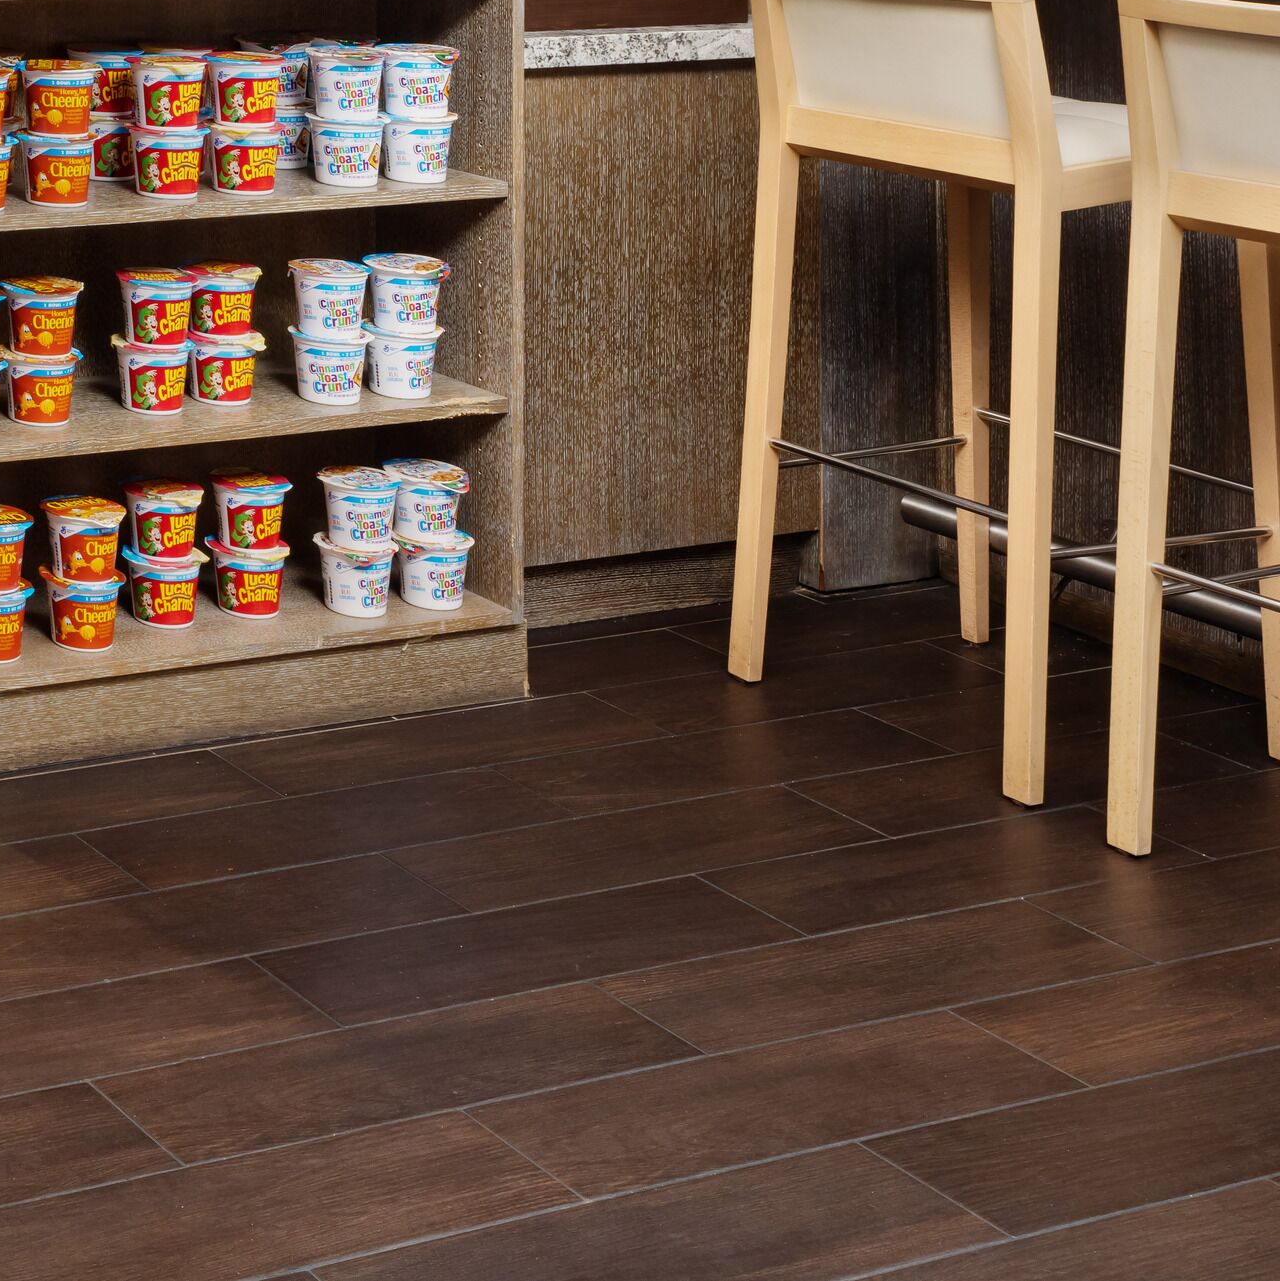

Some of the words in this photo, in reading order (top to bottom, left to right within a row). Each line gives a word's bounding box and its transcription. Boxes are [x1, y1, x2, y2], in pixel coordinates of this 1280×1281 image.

[309, 362, 355, 374] Cinnamon
[319, 371, 348, 383] Toast
[313, 379, 354, 394] Crunch
[243, 572, 278, 589] Lucky
[238, 587, 278, 604] Charms
